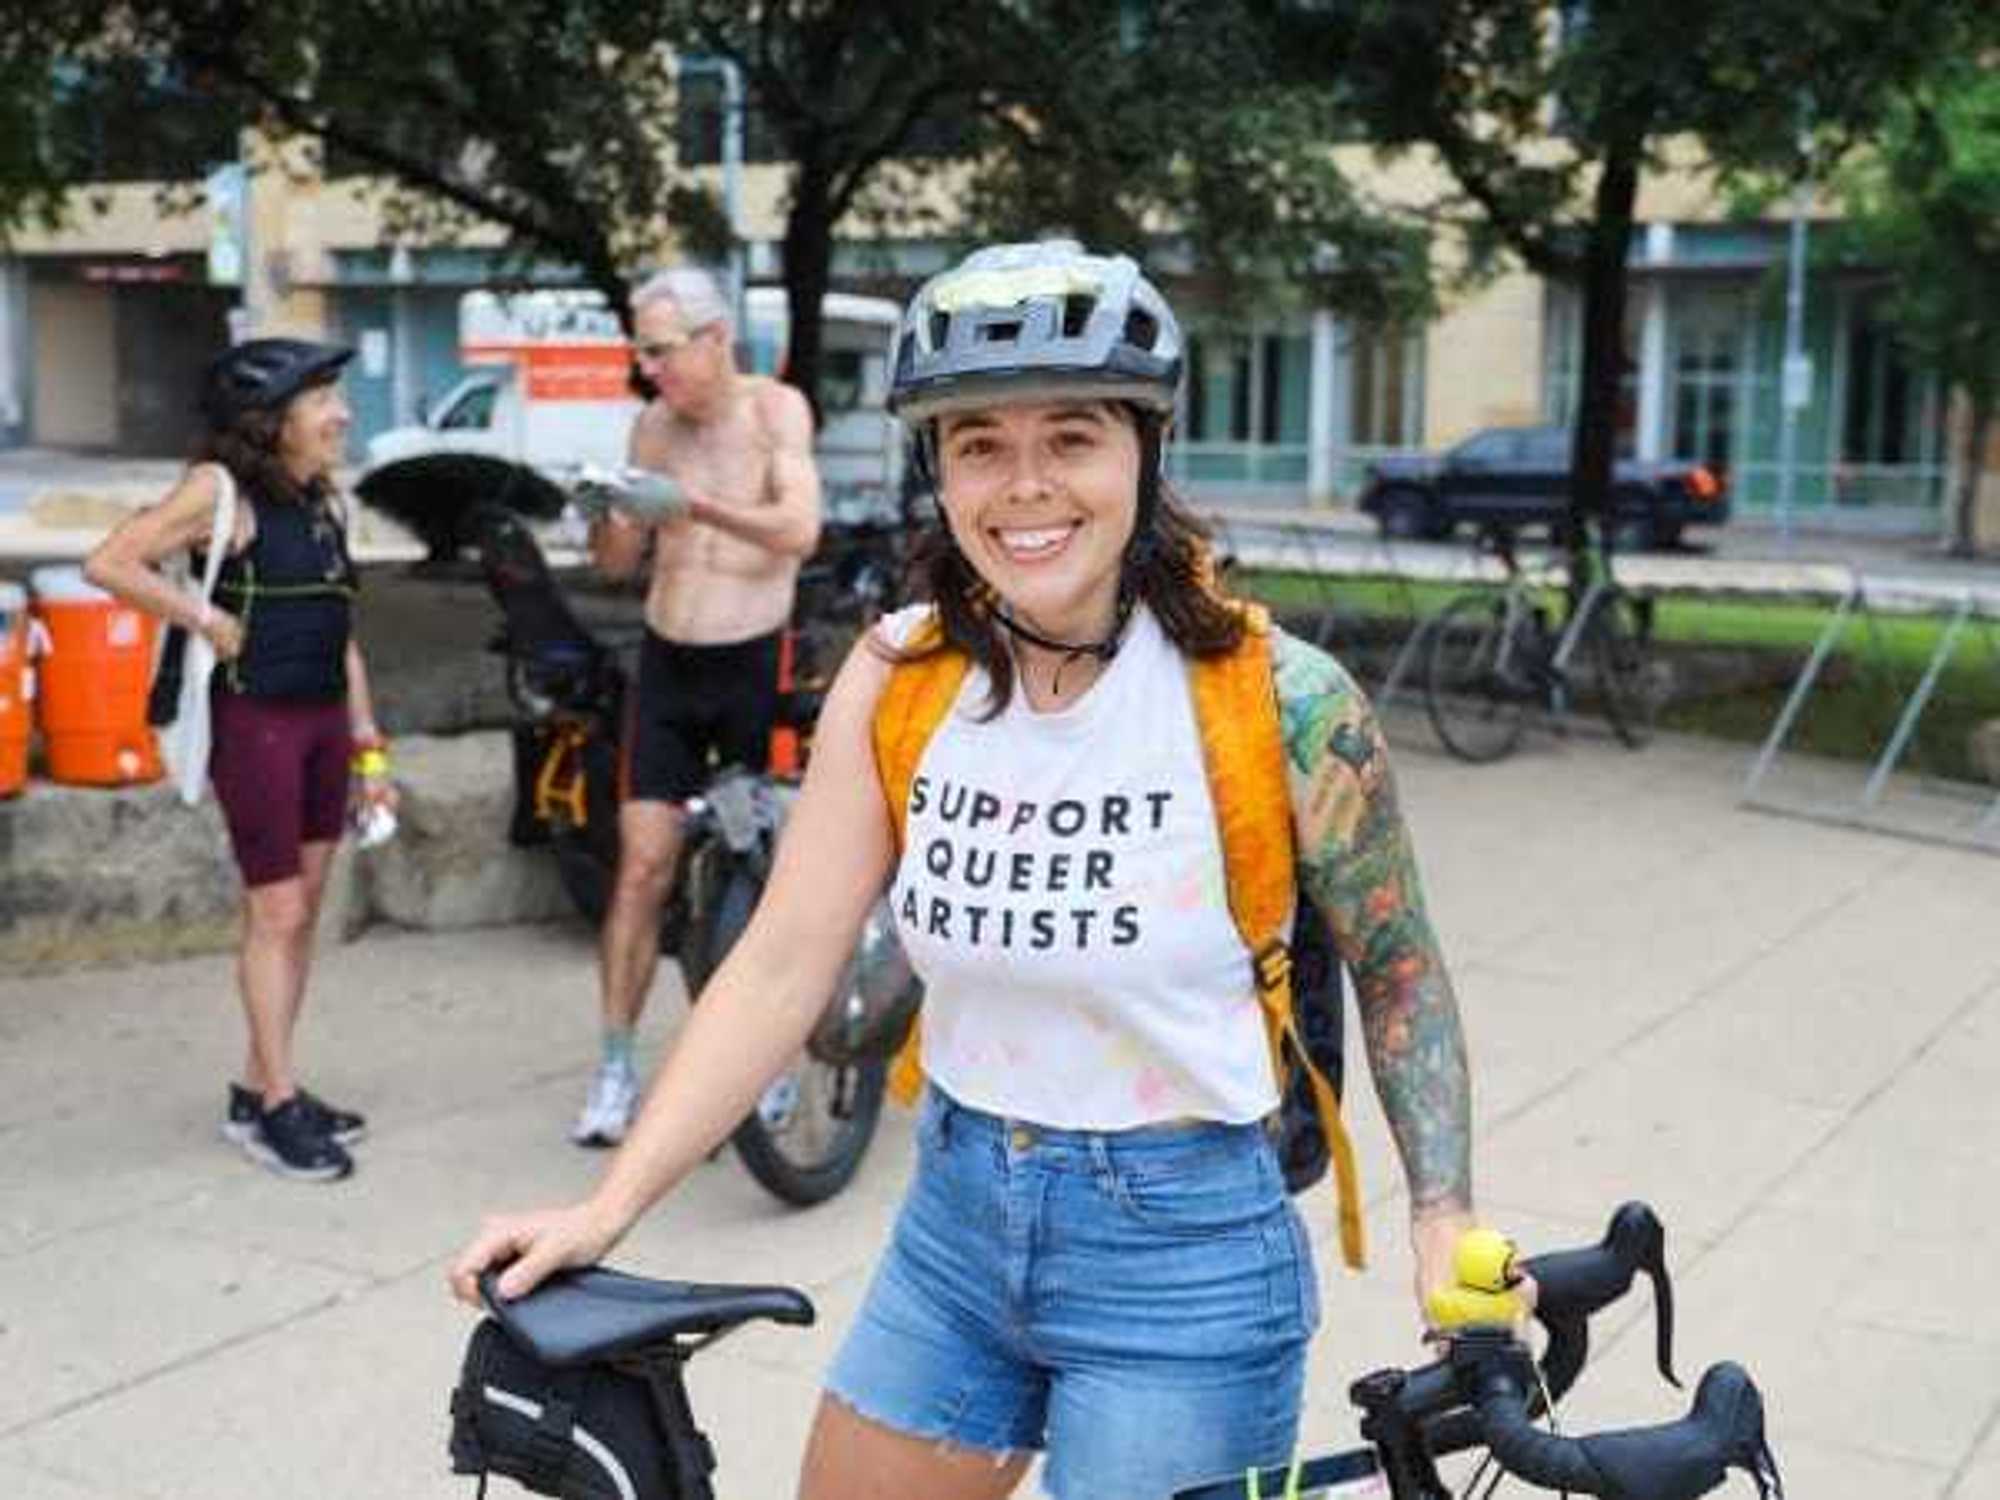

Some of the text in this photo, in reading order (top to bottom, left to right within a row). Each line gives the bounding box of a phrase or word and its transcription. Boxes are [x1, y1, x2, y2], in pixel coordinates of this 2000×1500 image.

[910, 776, 1173, 837] SUPPORT
[926, 839, 1115, 892] QUEER
[902, 887, 1139, 949] ARTISTS
